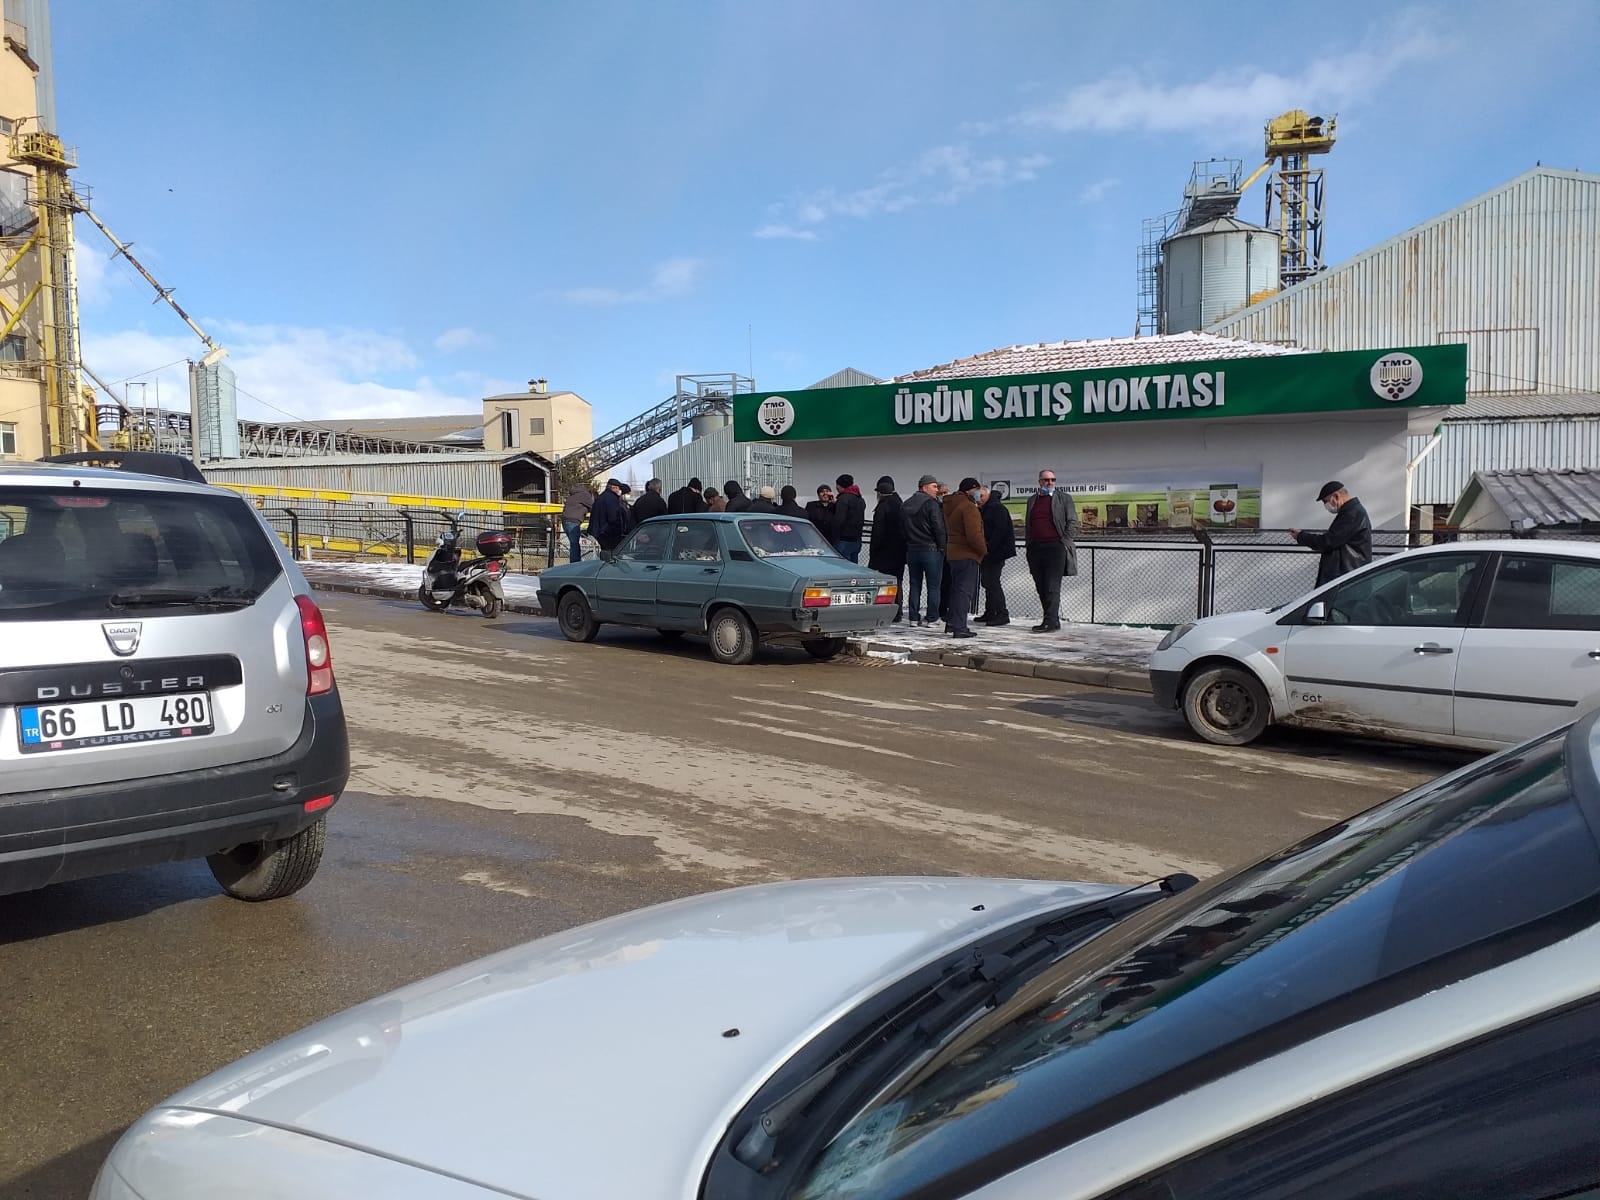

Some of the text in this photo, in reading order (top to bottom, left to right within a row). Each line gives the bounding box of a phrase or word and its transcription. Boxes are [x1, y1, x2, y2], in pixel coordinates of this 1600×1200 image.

[1379, 358, 1412, 368] TMO
[763, 401, 785, 409] TMO
[895, 371, 1226, 425] ÜRÜN SATIŞ NOKTASI
[37, 676, 204, 699] DUSTER
[40, 696, 205, 738] 66 LD 480
[25, 728, 40, 737] TR
